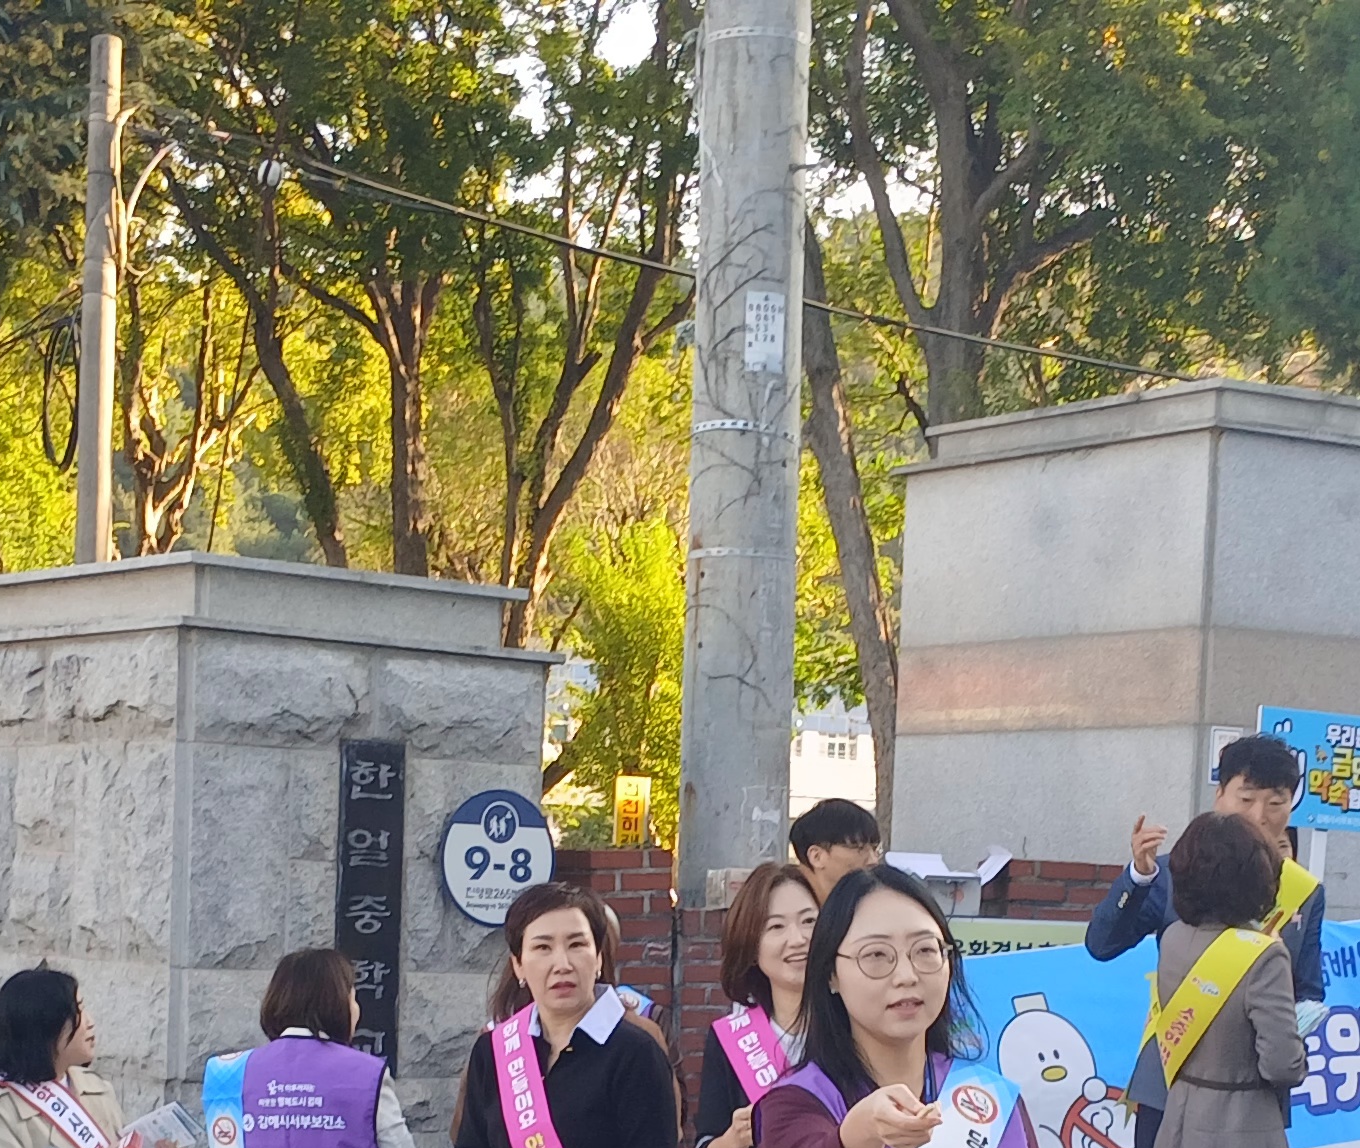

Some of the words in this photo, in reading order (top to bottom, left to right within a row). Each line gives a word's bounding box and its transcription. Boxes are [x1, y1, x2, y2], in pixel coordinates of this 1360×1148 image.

[464, 845, 532, 883] 9-8
[737, 1031, 778, 1087] 만들어
[257, 1113, 347, 1131] 김해시서부보건소
